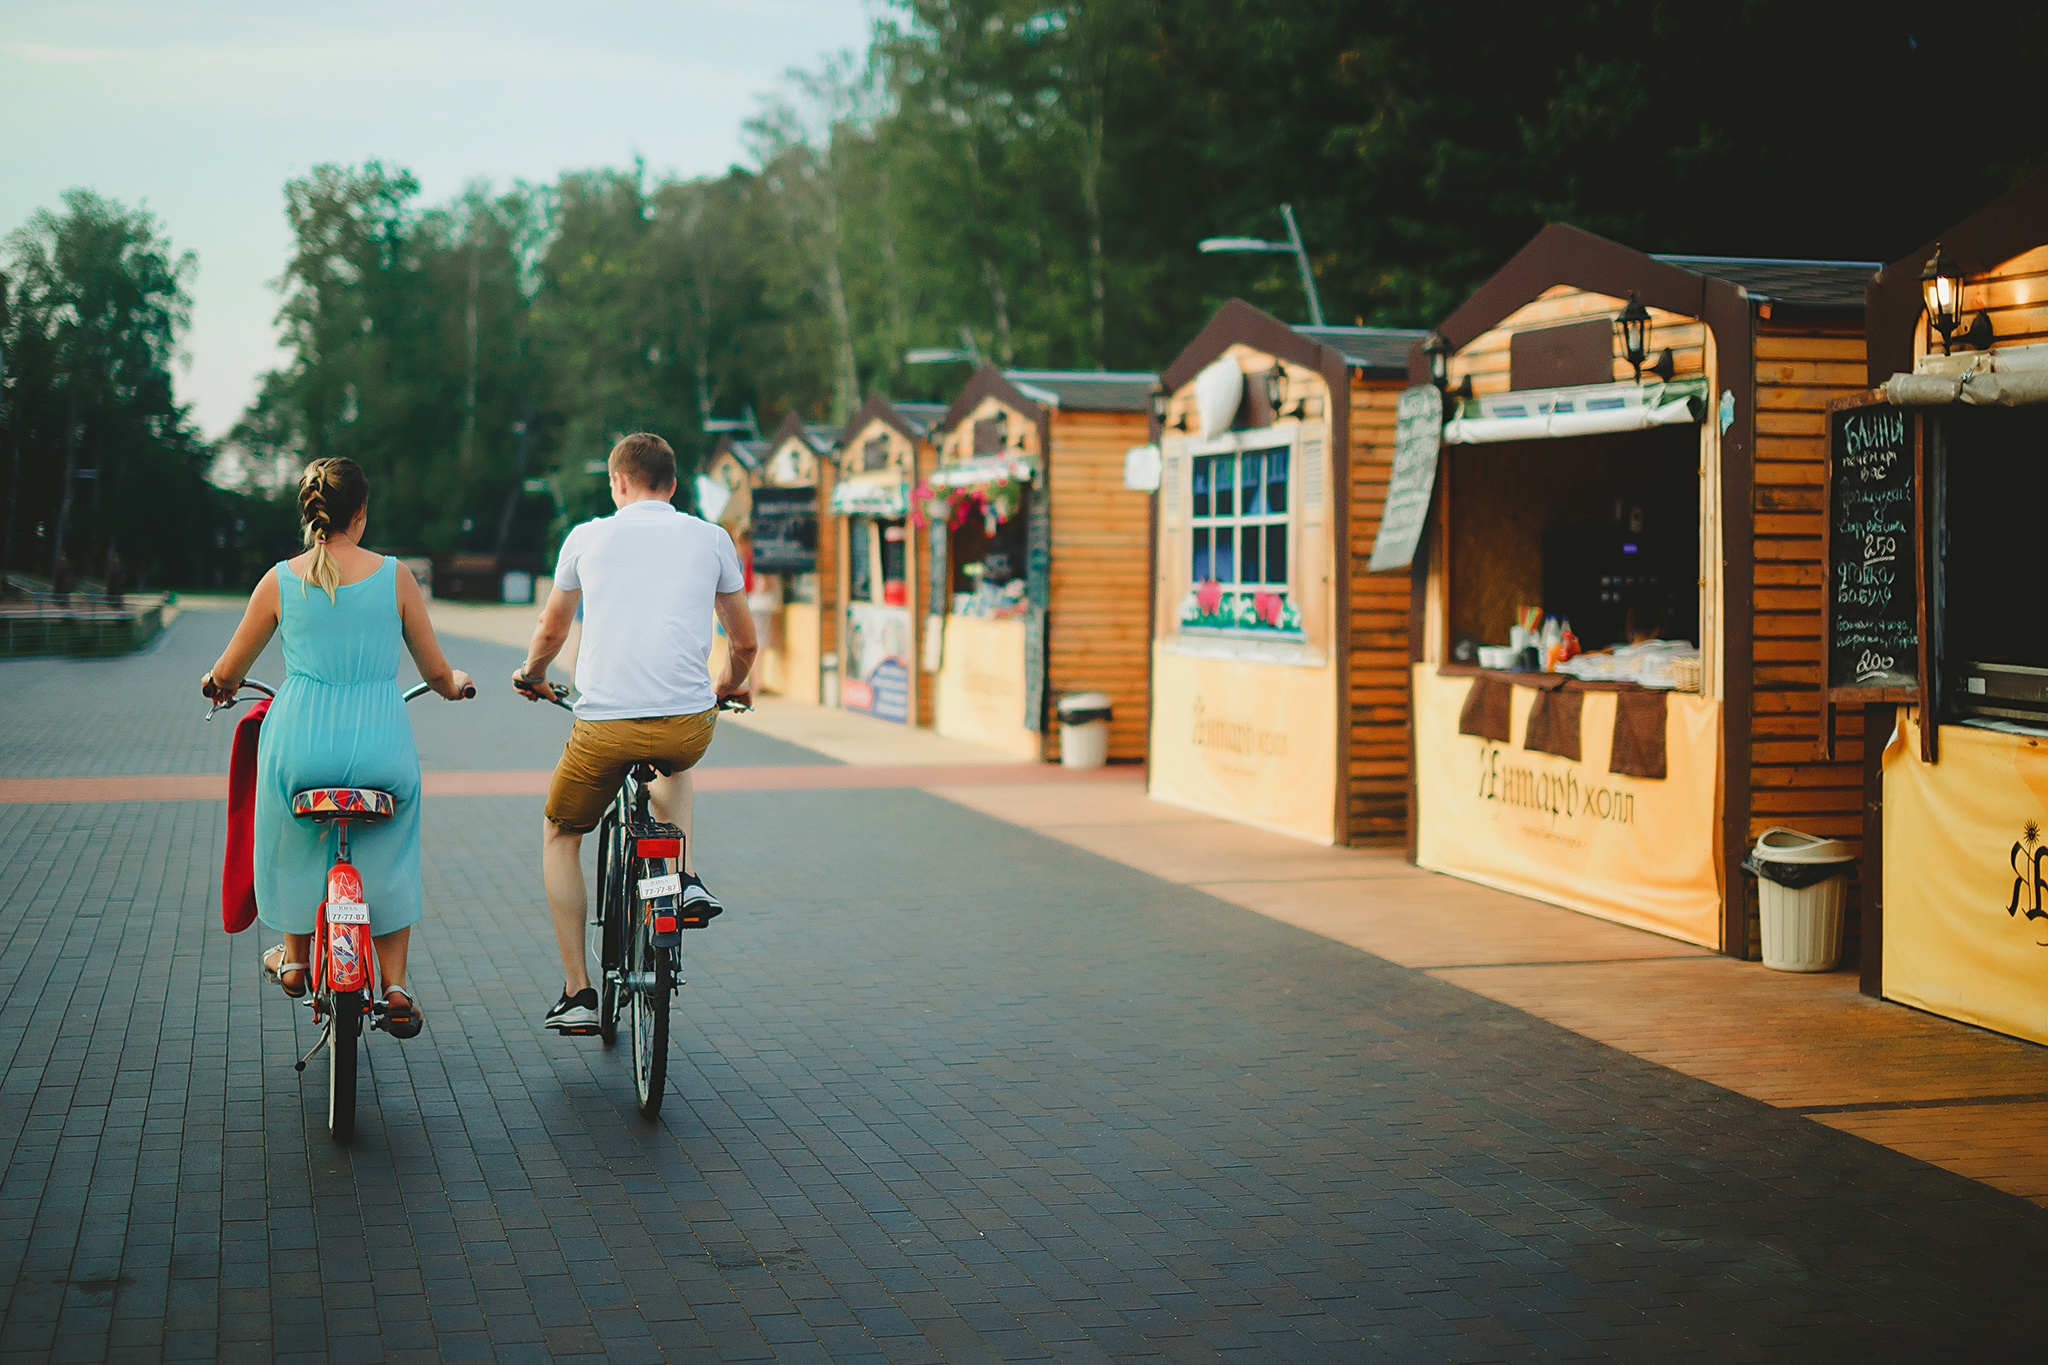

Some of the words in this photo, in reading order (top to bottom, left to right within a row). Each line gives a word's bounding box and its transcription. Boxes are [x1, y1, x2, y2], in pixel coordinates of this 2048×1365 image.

[1844, 411, 1903, 455] БЛИНЫ
[1864, 533, 1896, 560] 250
[1856, 649, 1894, 673] 200
[644, 884, 676, 895] 77-77-87
[331, 913, 365, 921] 77-77-87
